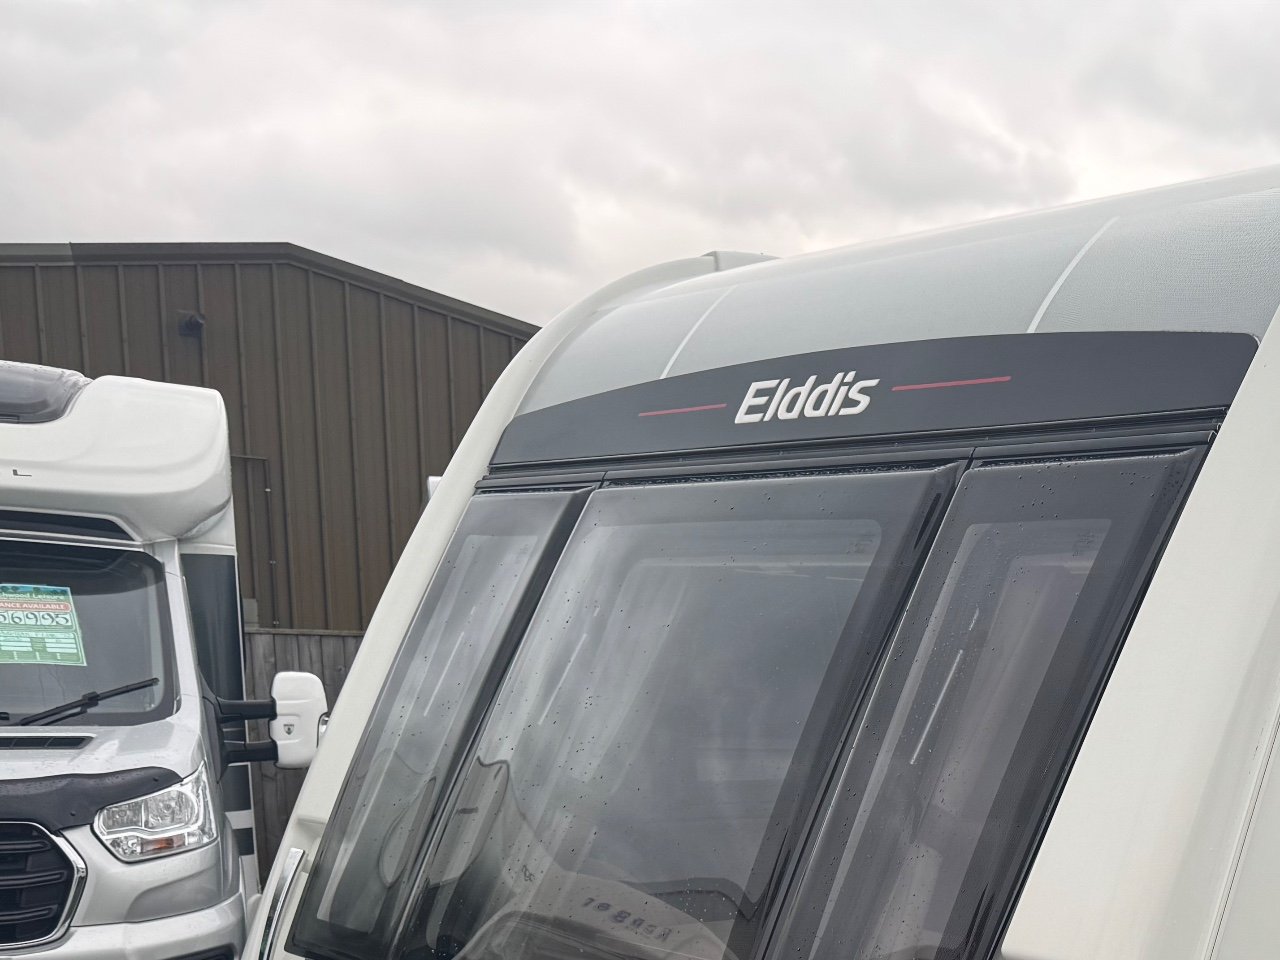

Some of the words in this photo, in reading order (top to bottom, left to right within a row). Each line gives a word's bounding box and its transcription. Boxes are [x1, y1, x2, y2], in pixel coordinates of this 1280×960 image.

[734, 370, 880, 424] Elddis
[0, 591, 30, 599] hwood
[33, 592, 65, 600] Leisure
[22, 602, 65, 610] AVAILABLE
